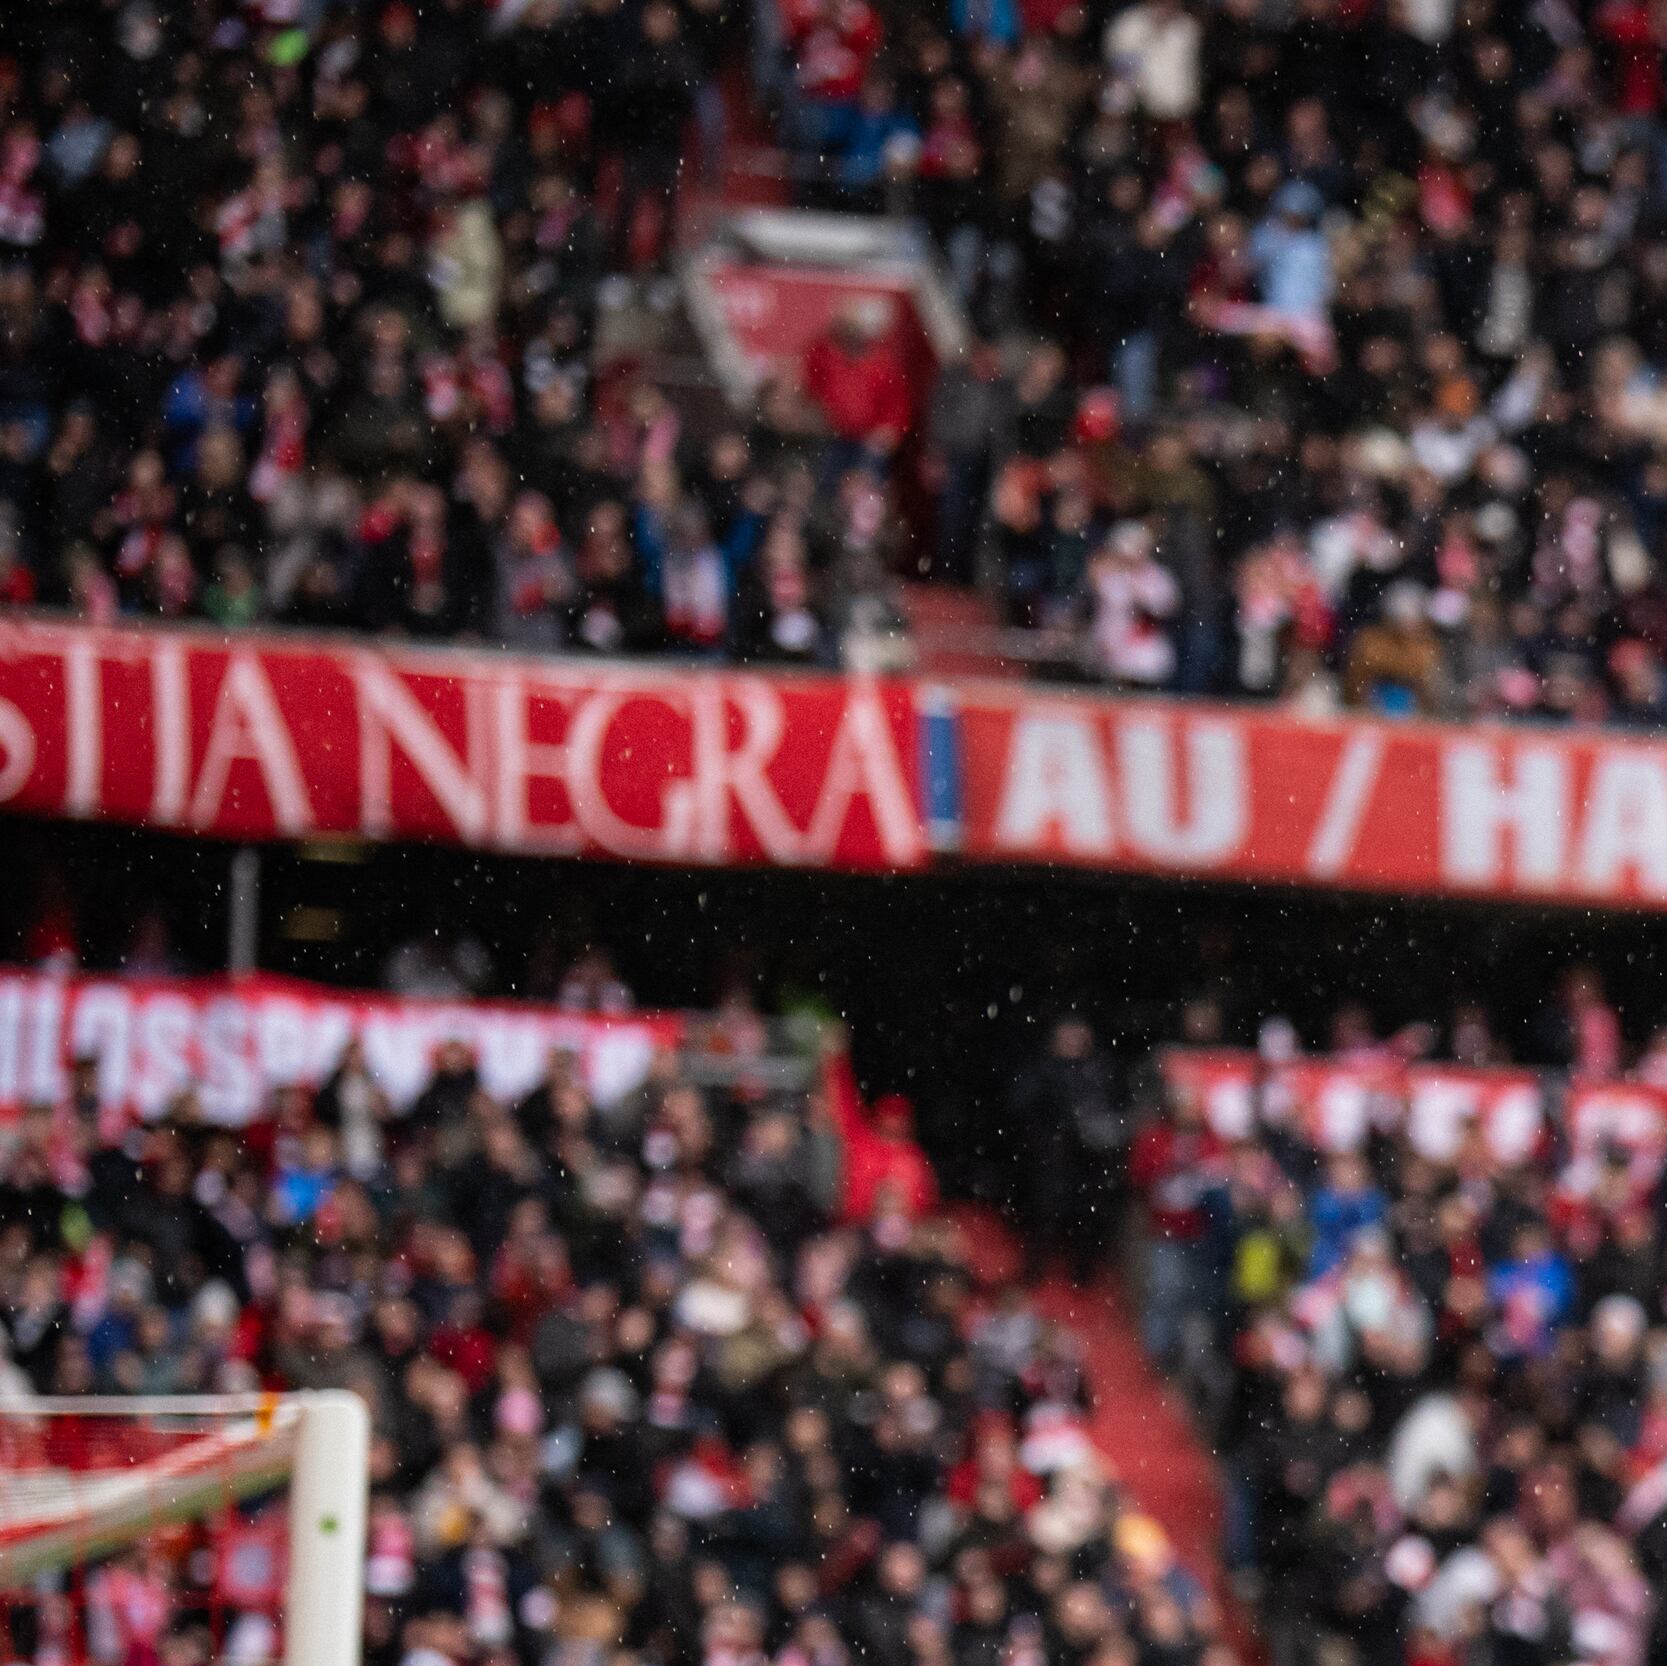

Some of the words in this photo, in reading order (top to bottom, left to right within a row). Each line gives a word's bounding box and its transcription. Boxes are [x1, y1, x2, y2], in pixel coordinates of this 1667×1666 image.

[350, 648, 932, 868] NEGRA
[998, 714, 1250, 868] AU
[1304, 726, 1385, 880] /
